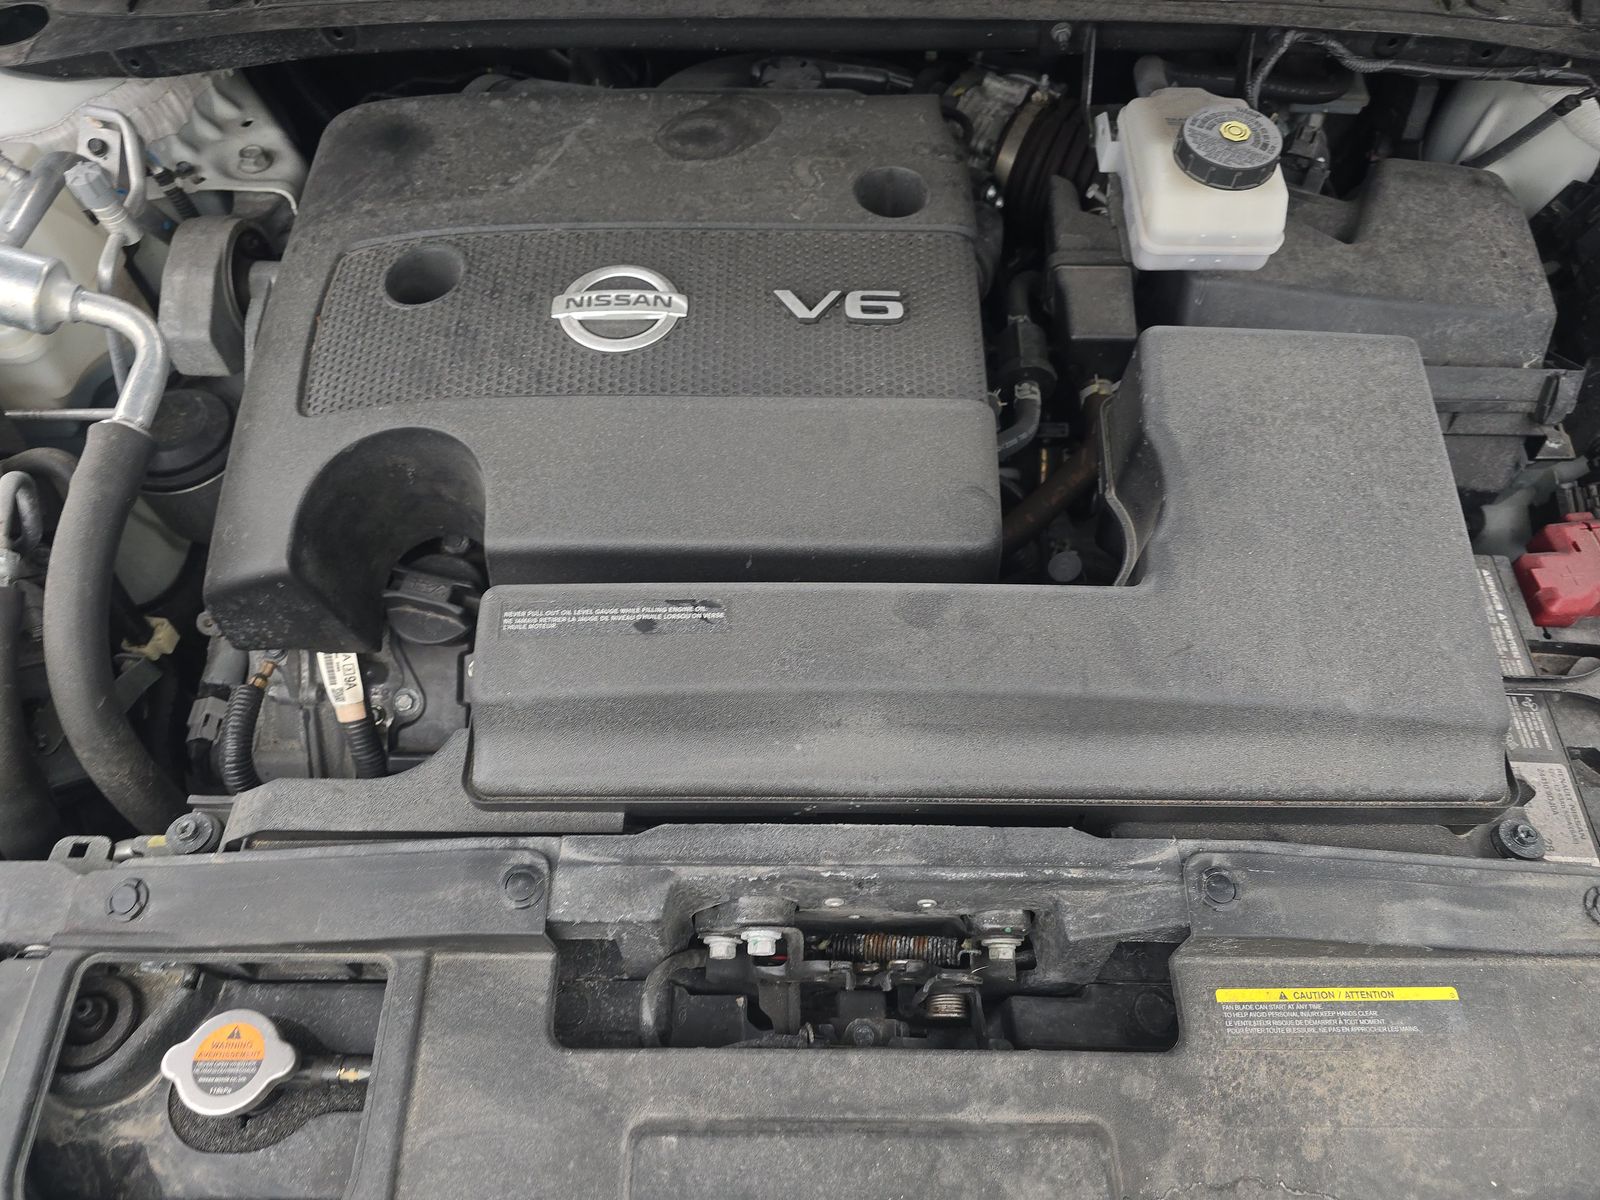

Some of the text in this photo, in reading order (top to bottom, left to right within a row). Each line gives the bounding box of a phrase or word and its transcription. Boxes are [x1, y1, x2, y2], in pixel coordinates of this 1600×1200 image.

[565, 295, 672, 309] NISSAN
[773, 289, 904, 324] V6
[573, 608, 593, 616] LEVEL
[595, 607, 619, 615] GAUGE
[620, 606, 640, 614] WHILE
[642, 606, 668, 614] FILLING
[1570, 804, 1587, 840] NISSAN
[1293, 991, 1335, 1000] CAUTION
[1344, 990, 1395, 999] ATTENTION
[1233, 1019, 1272, 1027] VENTILATEUR
[211, 1040, 254, 1049] WARNING
